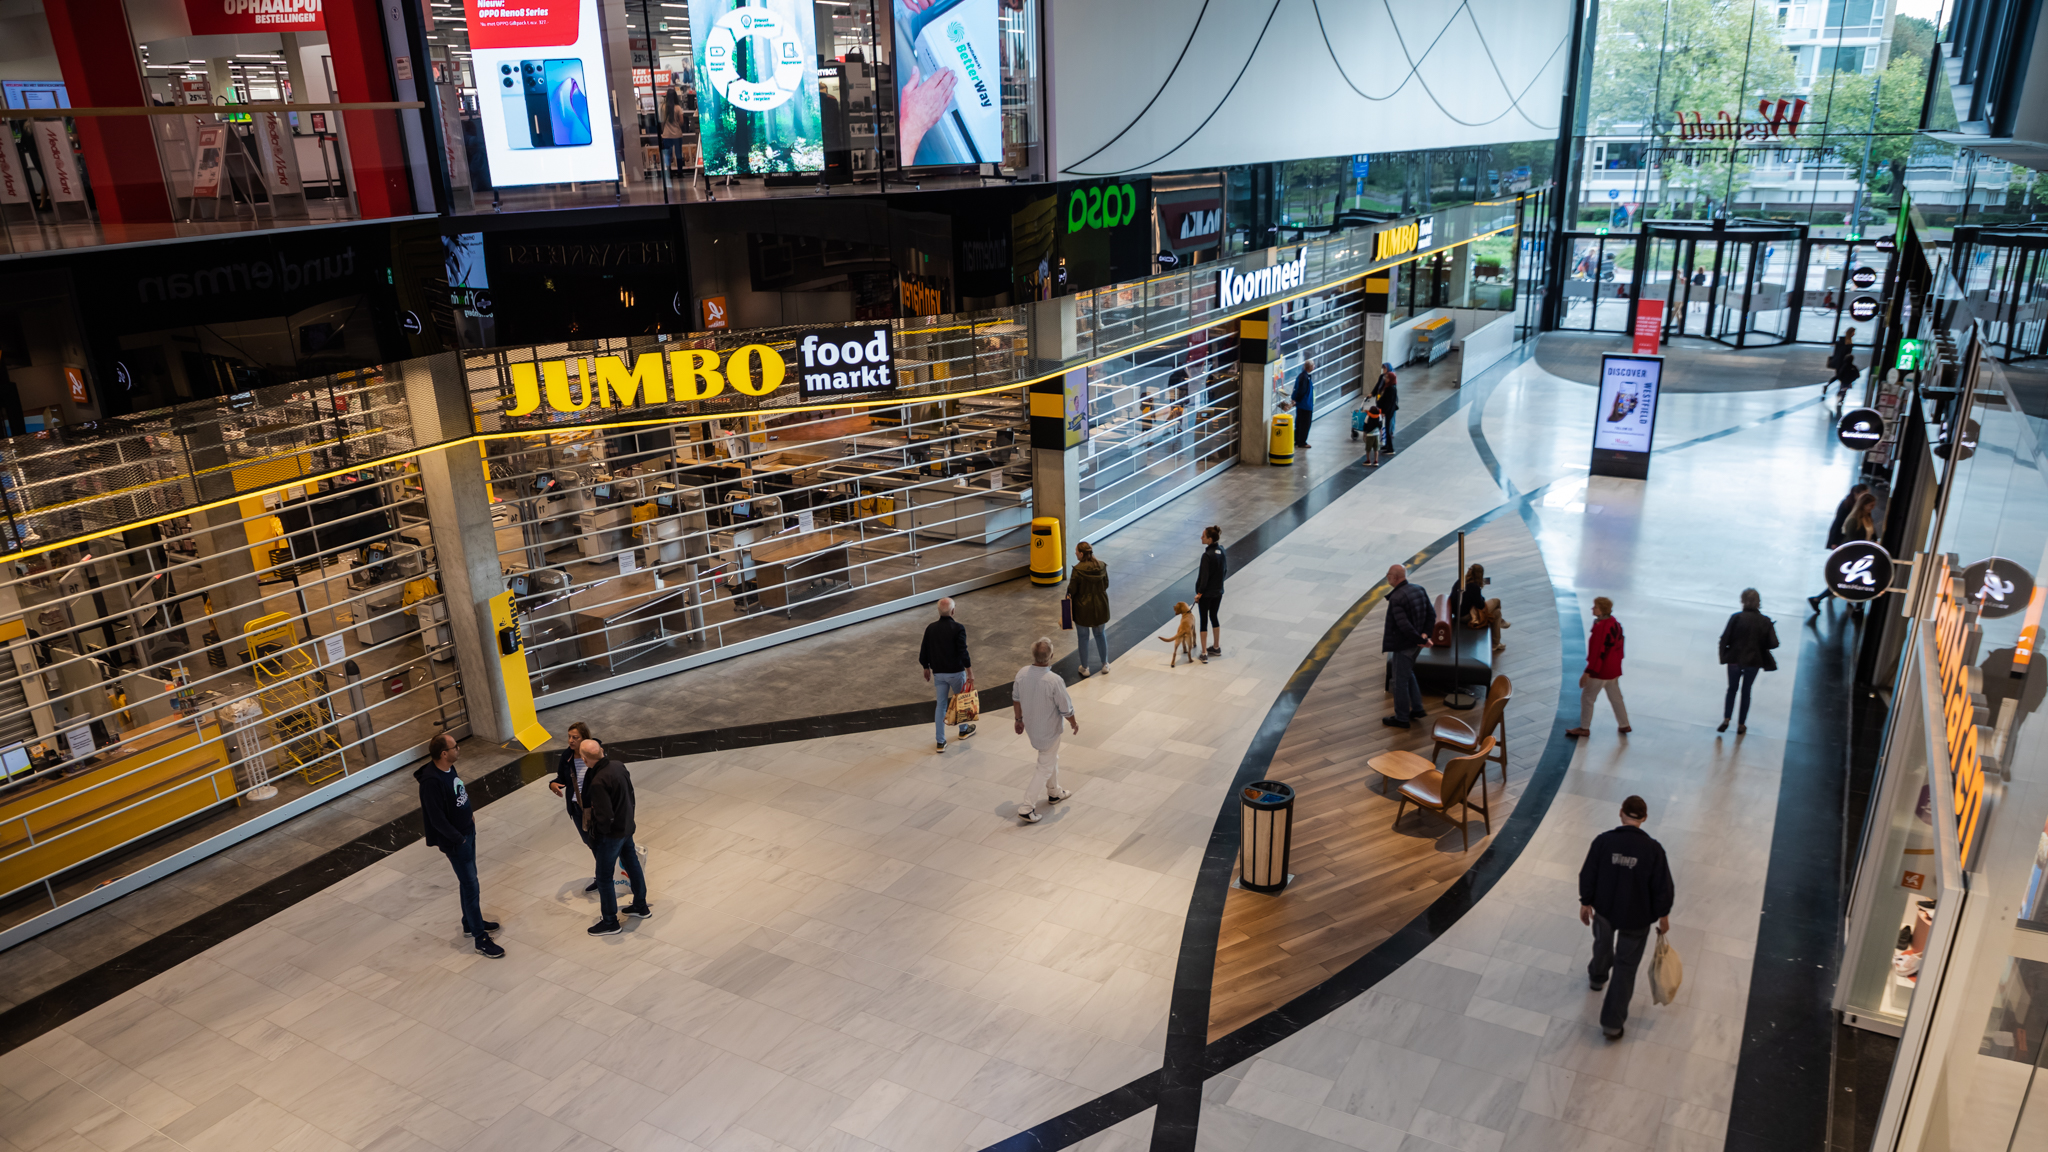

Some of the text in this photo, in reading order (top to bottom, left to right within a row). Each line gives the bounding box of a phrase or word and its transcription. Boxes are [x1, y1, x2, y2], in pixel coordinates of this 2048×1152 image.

[255, 13, 316, 24] BESTELLINGEN
[479, 8, 549, 18] OPPO Reno8 Series
[1375, 222, 1419, 262] JUMBO
[1220, 246, 1308, 308] Koornneef
[801, 330, 890, 367] food
[505, 343, 786, 416] JUMBO
[804, 363, 892, 391] markt
[1607, 367, 1648, 378] DISCOVER
[1639, 382, 1653, 425] WESTFIELD
[507, 595, 524, 647] JUMBO
